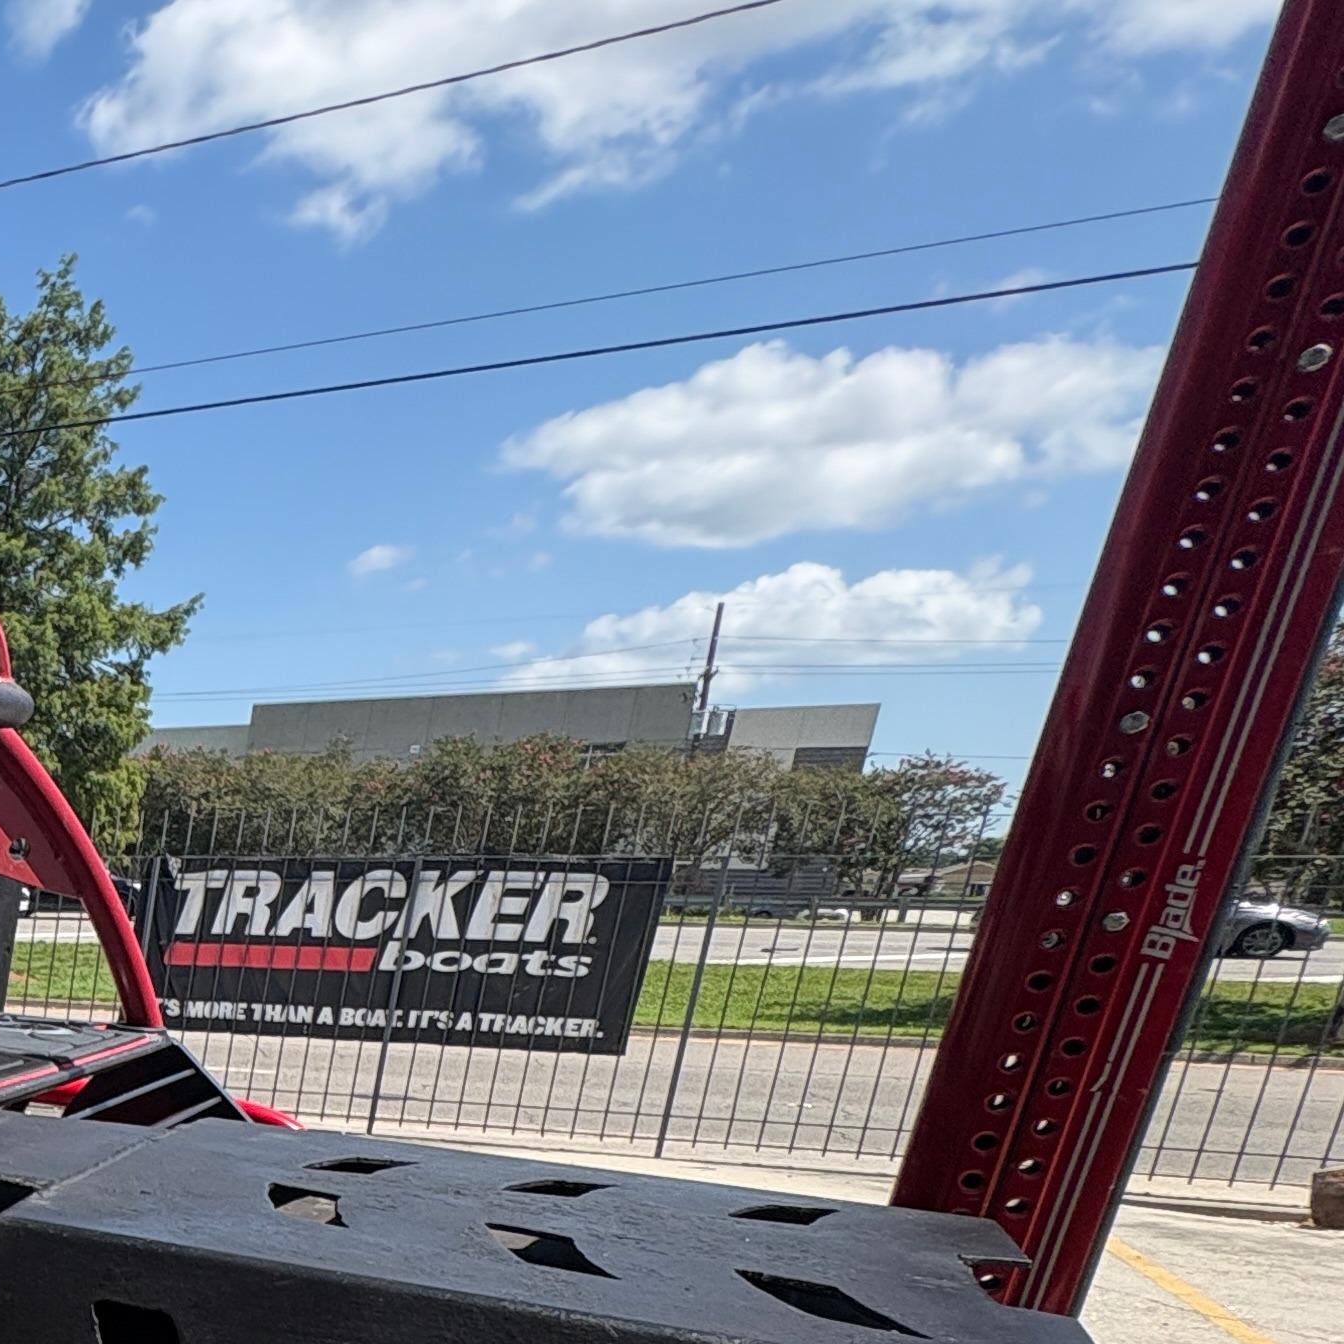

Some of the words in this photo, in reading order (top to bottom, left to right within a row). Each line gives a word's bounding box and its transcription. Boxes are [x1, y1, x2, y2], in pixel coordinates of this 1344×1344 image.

[173, 869, 610, 944] TRACKER
[1140, 864, 1199, 960] Blade
[378, 940, 592, 978] boats
[183, 1000, 246, 1021] MORE
[251, 1002, 314, 1024] THAN
[316, 1006, 334, 1025] A
[407, 1009, 454, 1030] IT'S
[455, 1012, 473, 1031] A
[478, 1012, 604, 1039] TRACKER.
